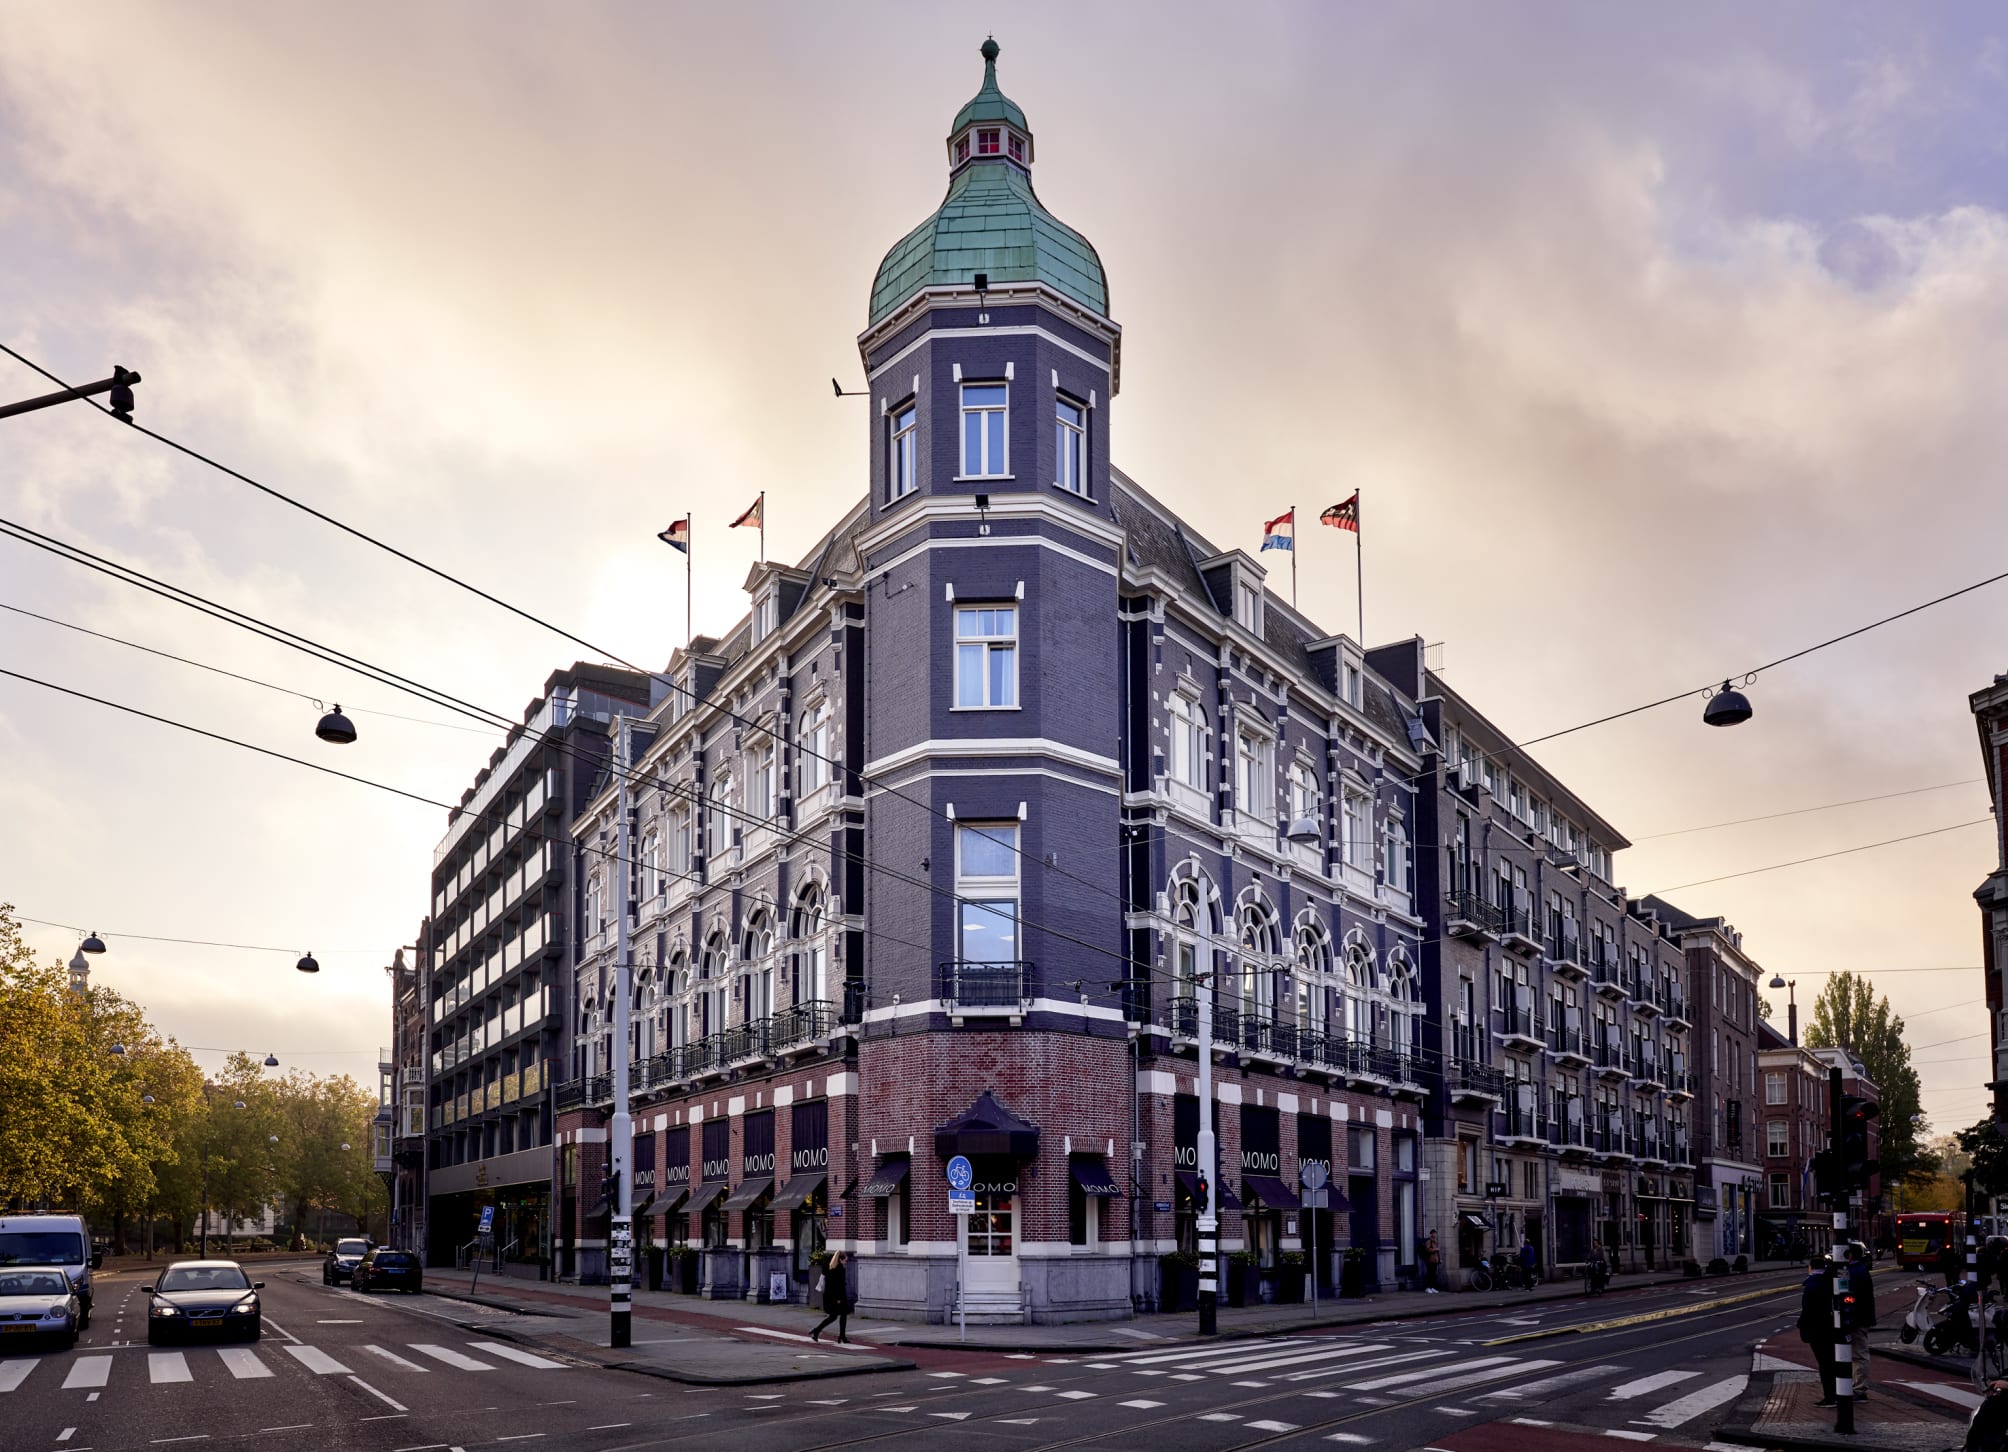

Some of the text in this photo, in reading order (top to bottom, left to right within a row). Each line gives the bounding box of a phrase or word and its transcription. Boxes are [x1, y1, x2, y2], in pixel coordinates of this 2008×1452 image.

[745, 1153, 775, 1173] MOMO
[793, 1147, 828, 1168] MOMO
[1175, 1146, 1196, 1166] MO
[1241, 1151, 1278, 1170] MOMO
[667, 1165, 690, 1181] MOMO
[704, 1159, 729, 1177] MOMO
[635, 1170, 655, 1185] MOMO
[862, 1183, 896, 1194] MOMO
[968, 1182, 1016, 1192] OMO
[1081, 1183, 1119, 1193] MOMO
[484, 1207, 492, 1218] P
